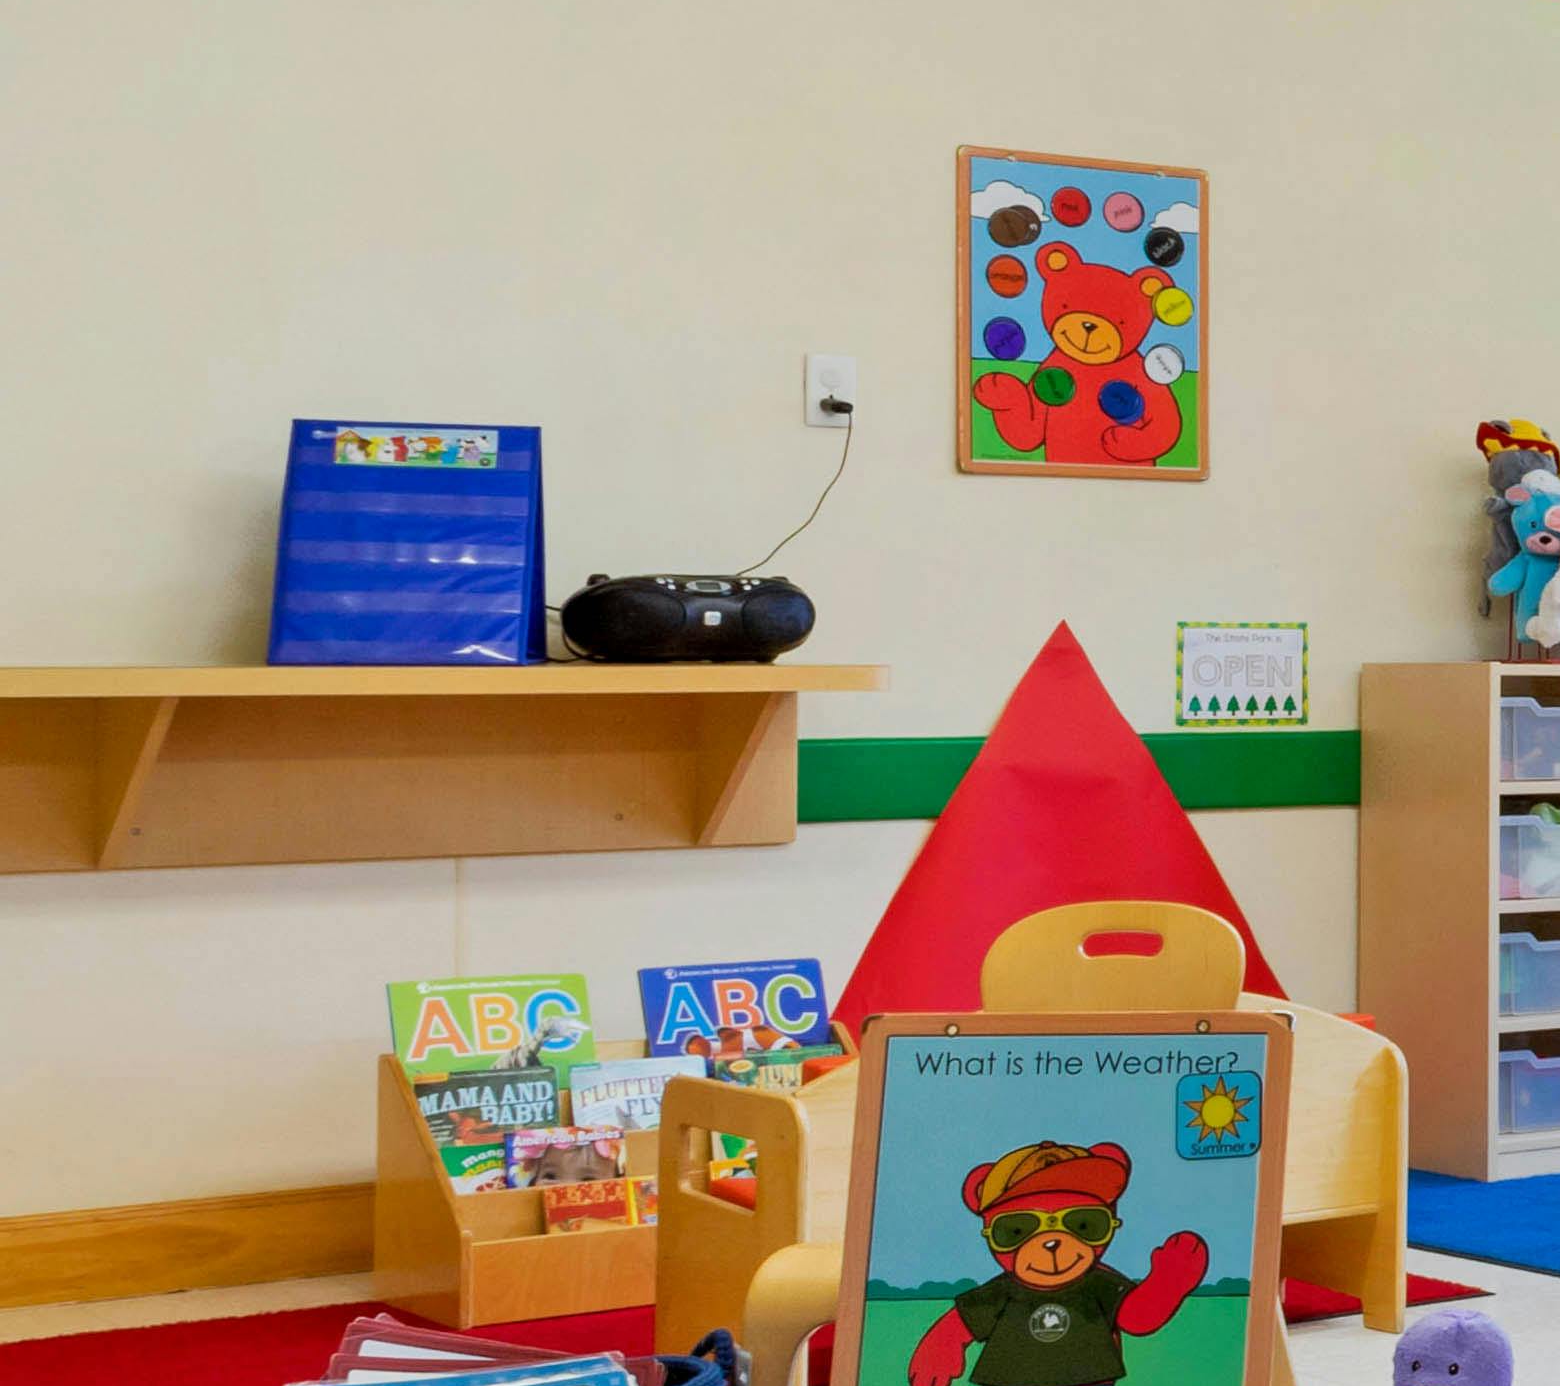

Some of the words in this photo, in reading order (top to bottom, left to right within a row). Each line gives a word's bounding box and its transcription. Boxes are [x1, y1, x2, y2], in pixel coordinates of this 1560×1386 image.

[1192, 653, 1293, 688] OPEN
[407, 990, 582, 1063] ABC
[656, 974, 819, 1046] ABC
[915, 1051, 997, 1077] What
[1005, 1051, 1024, 1076] is
[1034, 1050, 1083, 1076] the
[1095, 1049, 1240, 1077] Weather?
[416, 1086, 502, 1116] MAMA
[502, 1080, 554, 1104] AND
[480, 1100, 554, 1125] BABY!
[1190, 1141, 1246, 1156] Summer
